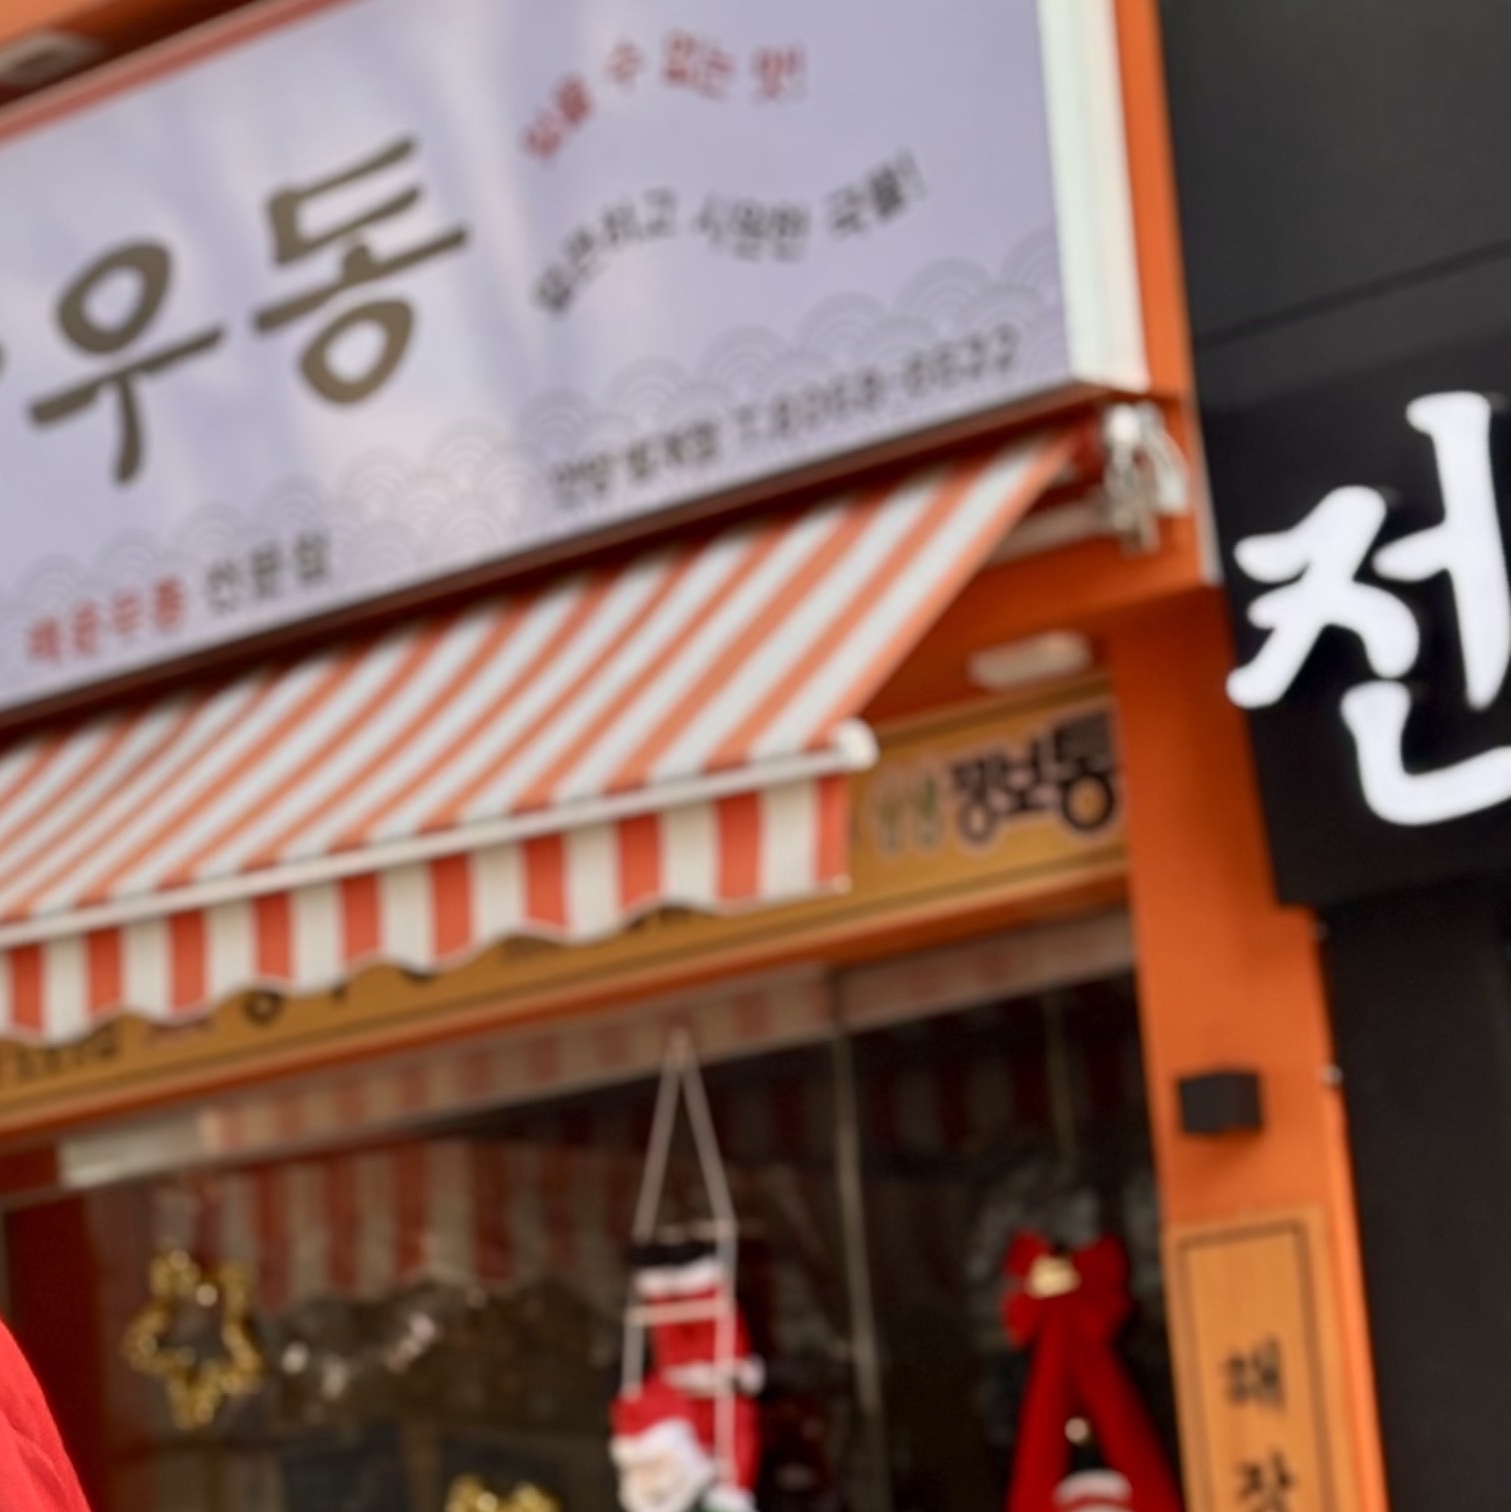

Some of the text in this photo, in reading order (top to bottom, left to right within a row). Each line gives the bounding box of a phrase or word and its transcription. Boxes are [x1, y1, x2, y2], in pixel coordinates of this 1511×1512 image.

[605, 40, 643, 90] 수
[661, 28, 737, 102] 없는
[694, 189, 812, 263] 시원한
[204, 530, 331, 612] 전문점
